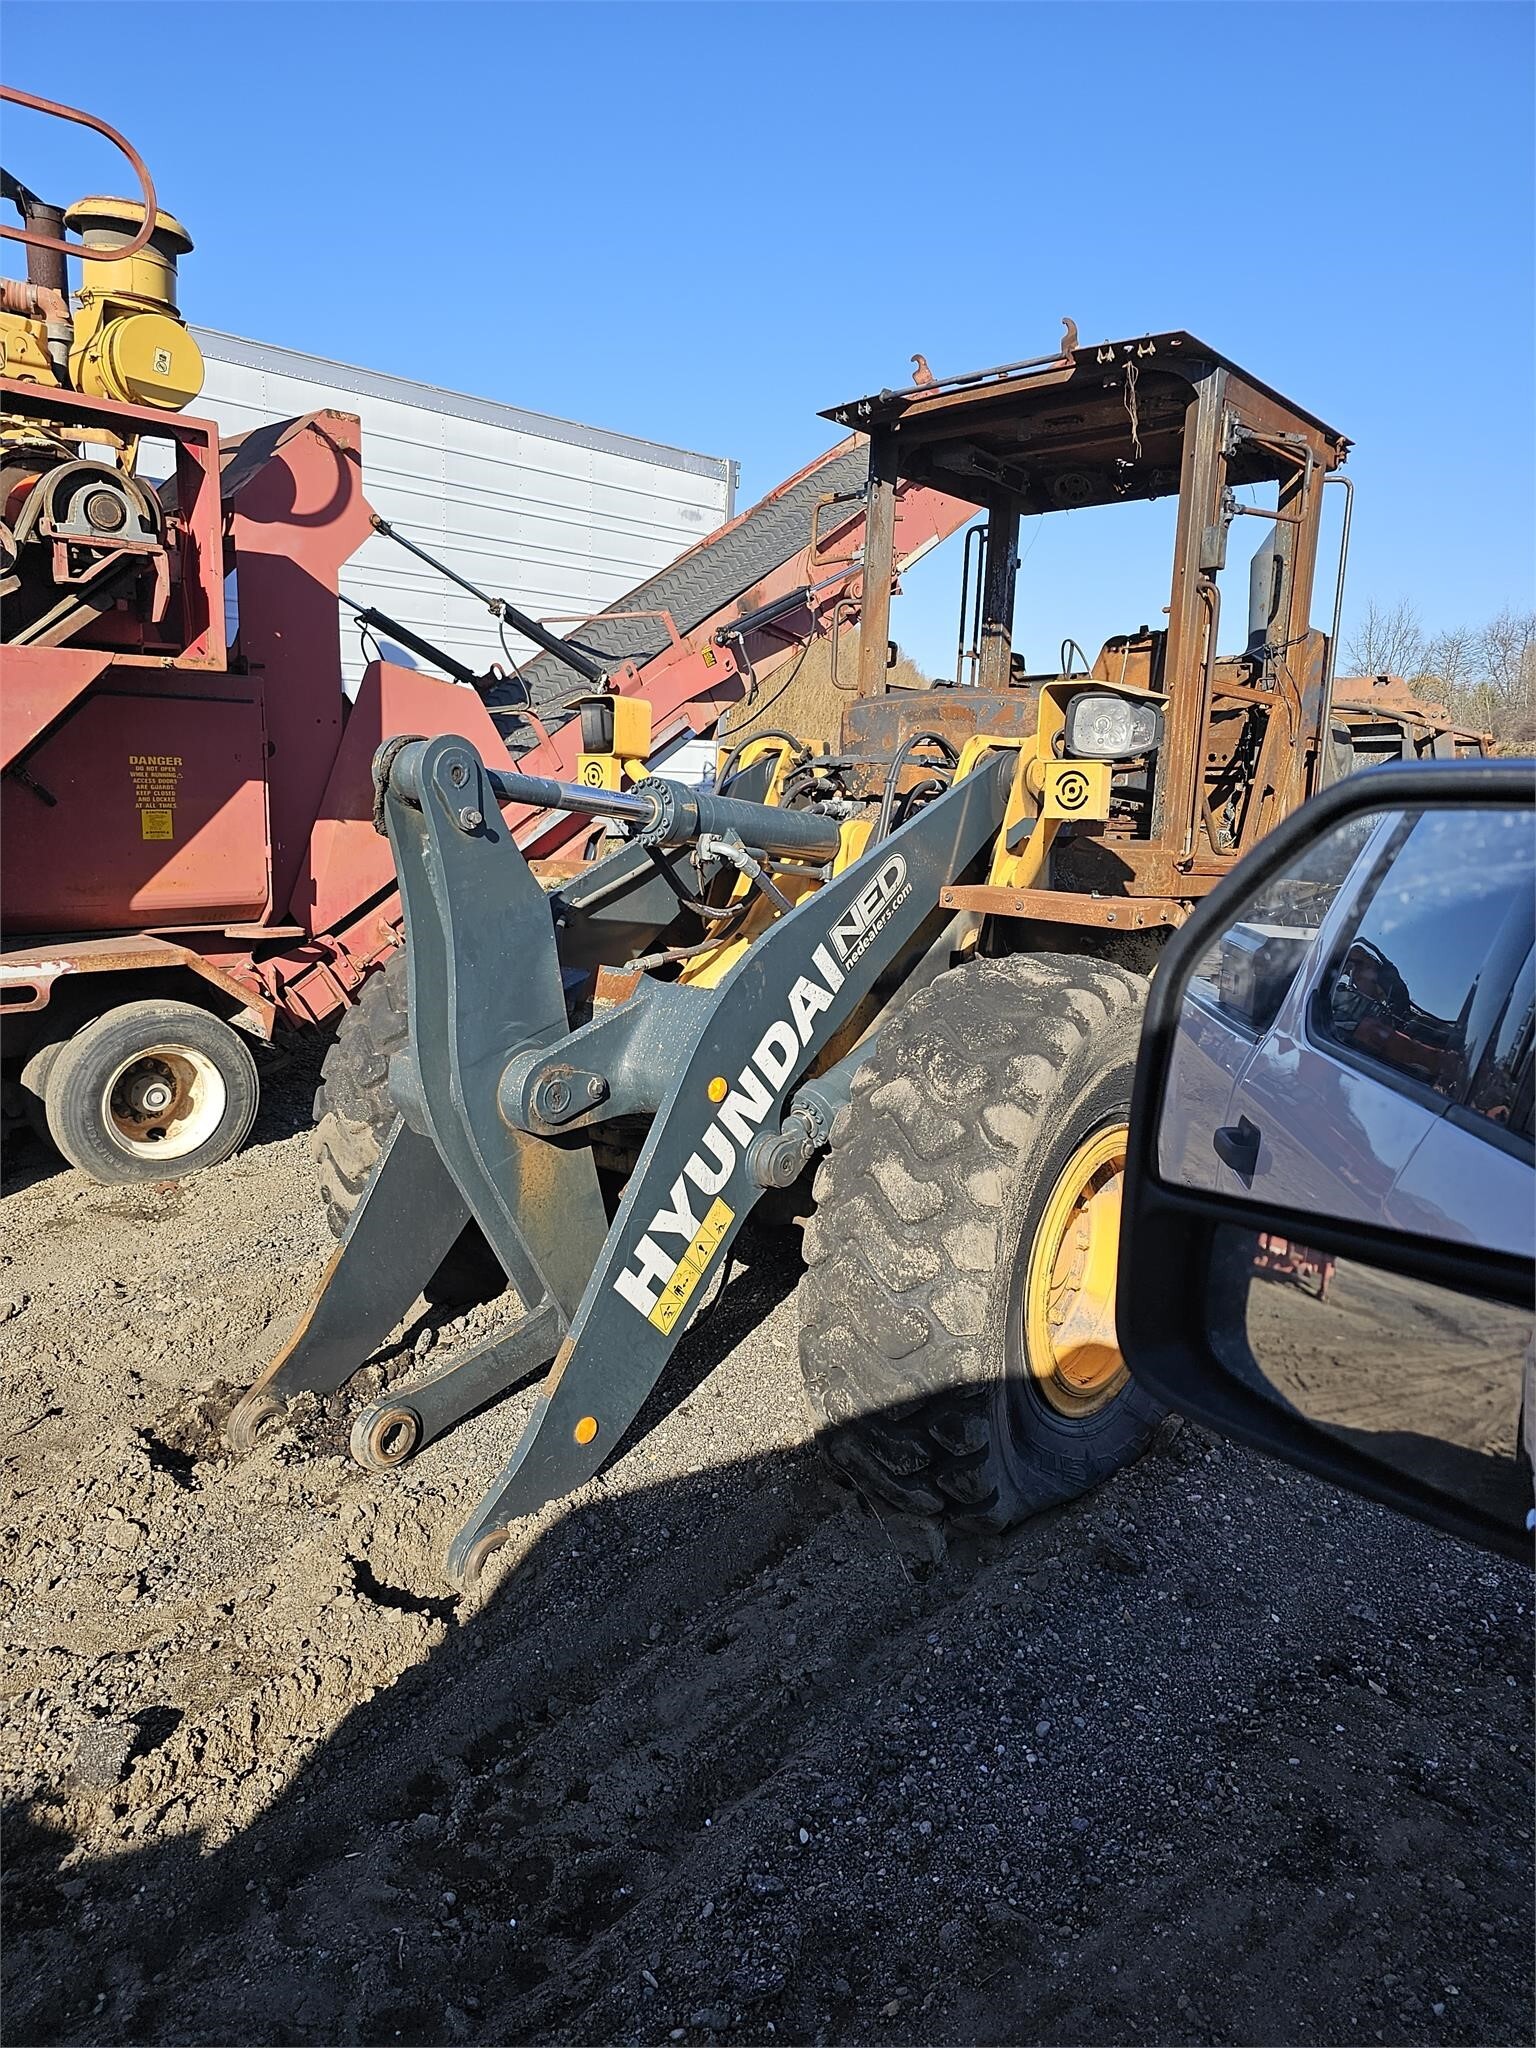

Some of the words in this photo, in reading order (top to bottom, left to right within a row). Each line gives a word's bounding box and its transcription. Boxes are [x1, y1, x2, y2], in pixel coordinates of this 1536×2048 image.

[129, 756, 183, 766] DANGER
[829, 853, 907, 962] NED
[844, 882, 913, 972] nedealers.com
[613, 942, 846, 1320] HYUNDAI
